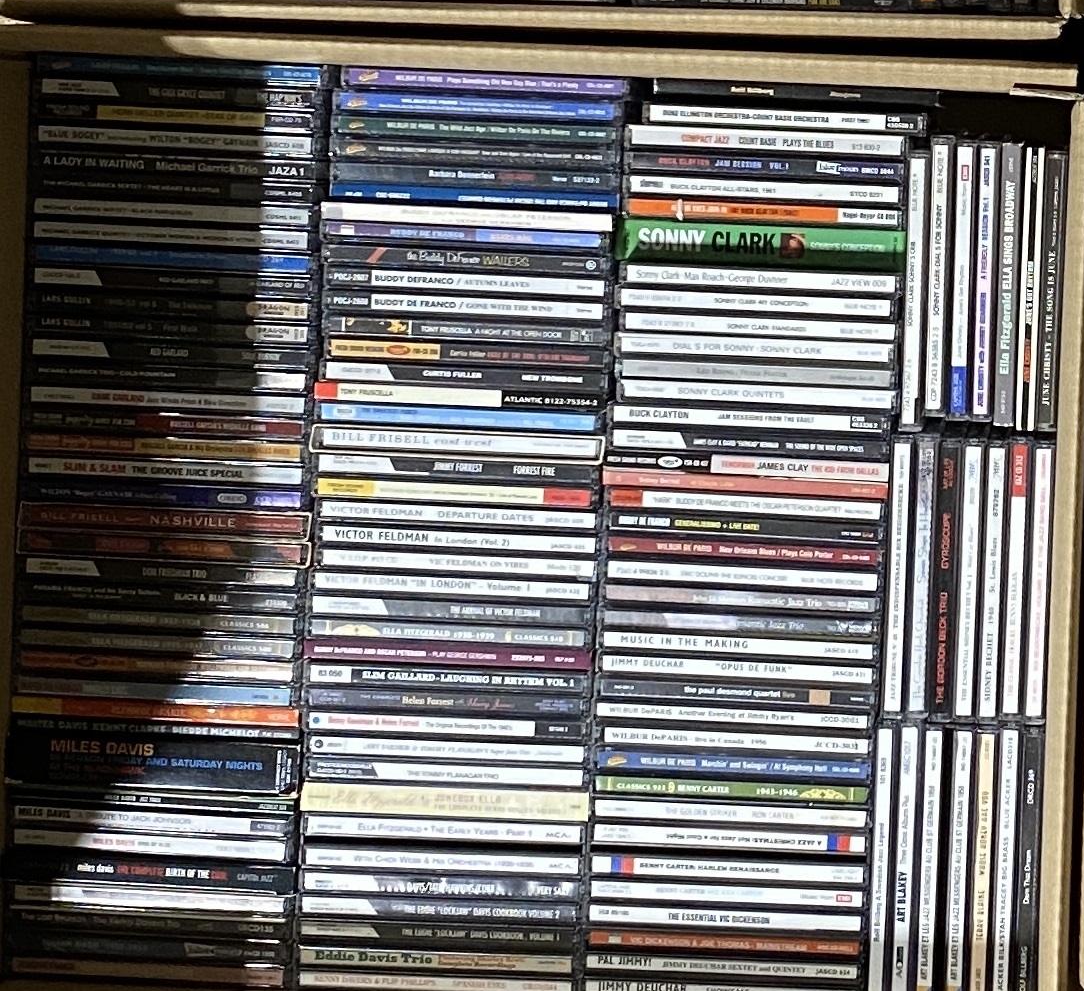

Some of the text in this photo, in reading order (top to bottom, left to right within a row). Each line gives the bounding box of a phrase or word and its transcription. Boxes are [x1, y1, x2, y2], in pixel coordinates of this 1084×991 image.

[714, 135, 729, 144] JAZZ
[54, 156, 297, 176] LADY WAITING Michael JAZA
[638, 228, 776, 254] SONNY CLARK
[374, 275, 454, 285] BUDDY DEFRANCO
[1000, 181, 1016, 374] Ella Fitzgerald ELLA SINGS BROADWAY
[374, 299, 456, 309] BUDDY FRANCO
[332, 432, 429, 444] BILL FRISELL
[132, 465, 243, 478] THE GROOVE JUICE SPECIAL
[757, 462, 808, 472] JAMES CLAY
[330, 506, 422, 517] VICTOR FELDMAN
[150, 515, 236, 527] NASHVILLE
[335, 530, 428, 542] VICTOR FELDMAN
[621, 636, 748, 649] MUSIC IN THE MAKING
[611, 658, 638, 667] JIMMY
[684, 686, 715, 697] the paul
[51, 740, 154, 756] MILES DAVIS
[146, 757, 262, 771] AND SATURDAY NIGHTS
[896, 872, 907, 923] ART BLAKEY
[314, 951, 432, 963] Eddie Davis Trio
